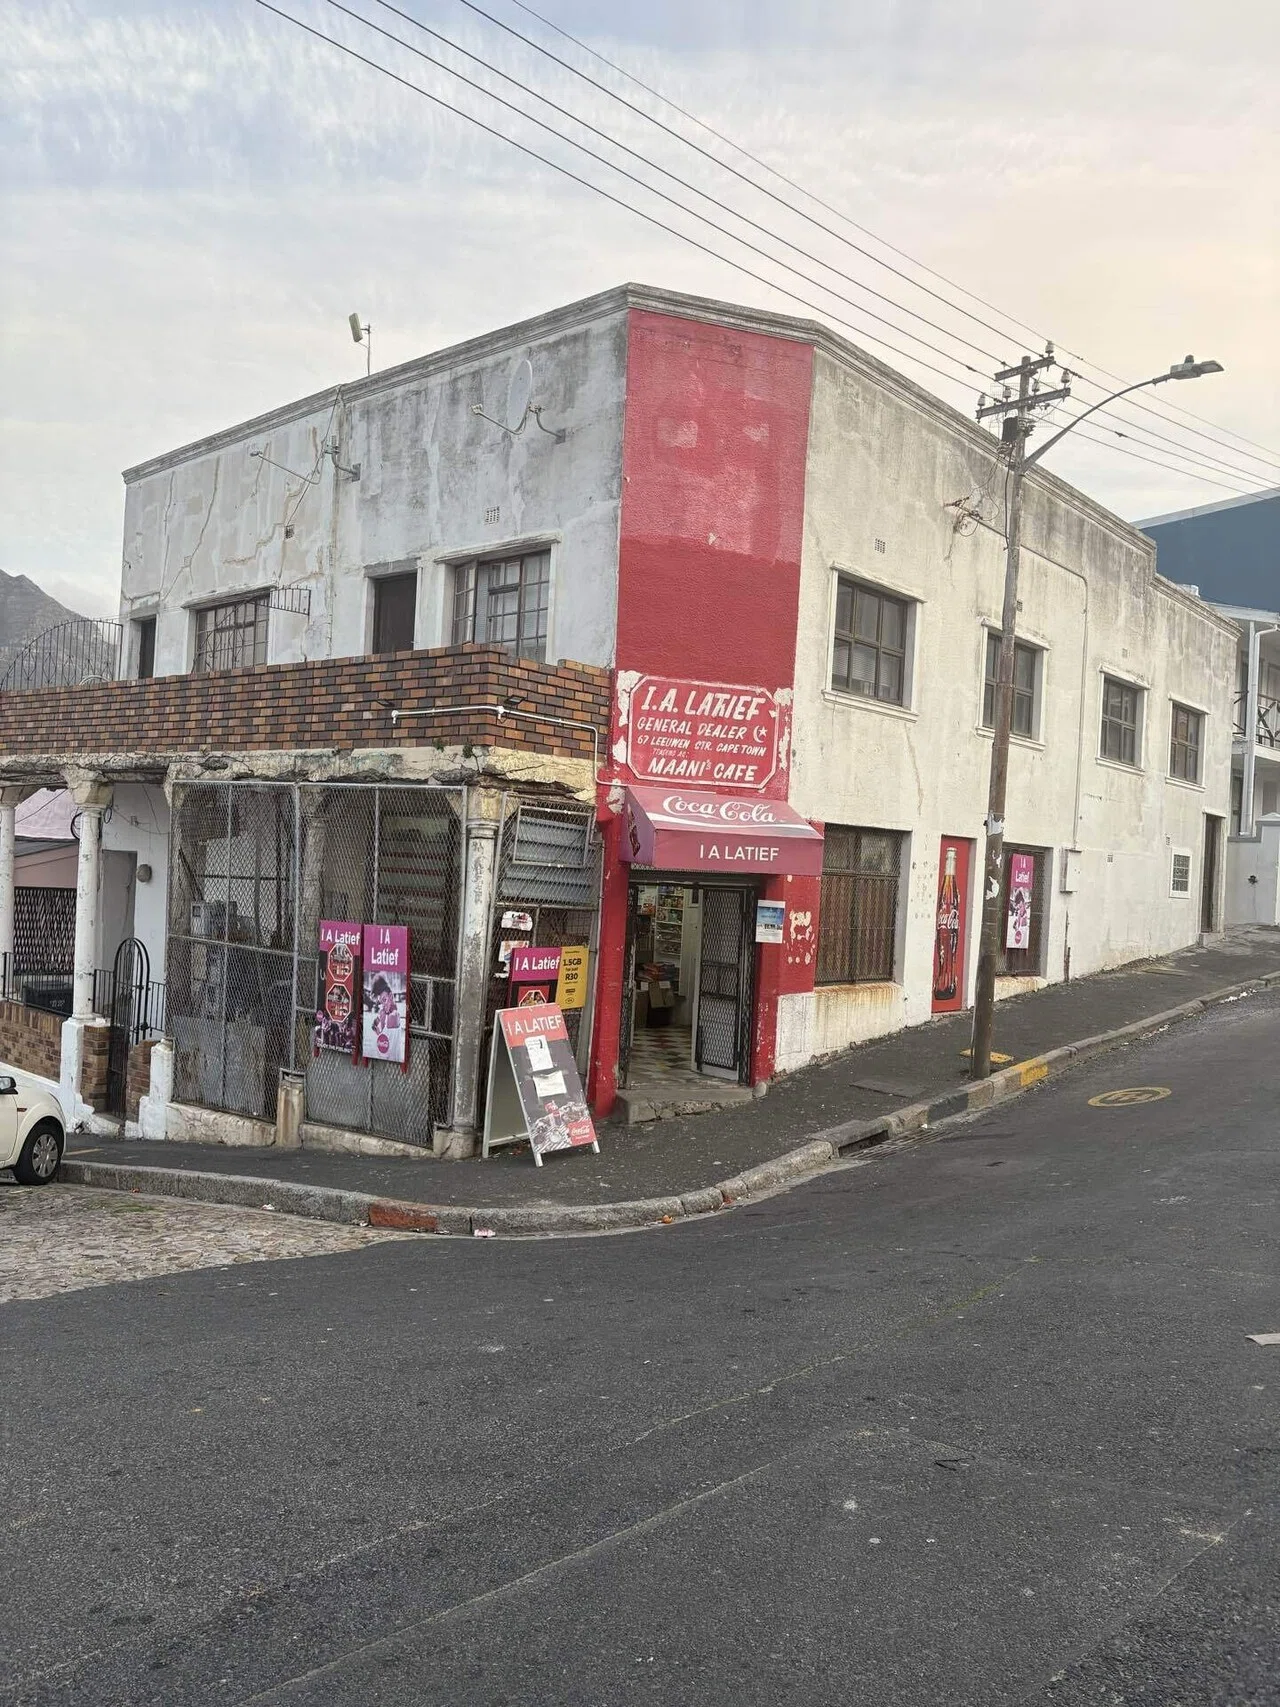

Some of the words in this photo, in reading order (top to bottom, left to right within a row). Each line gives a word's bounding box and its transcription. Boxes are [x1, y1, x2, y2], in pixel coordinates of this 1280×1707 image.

[641, 686, 679, 713] I.A.
[684, 690, 766, 721] LATIEF
[637, 716, 692, 735] GENERAL
[697, 723, 748, 740] DEALER
[637, 735, 649, 745] 67
[650, 736, 690, 749] LEEUWEN
[716, 742, 740, 753] CAPE
[741, 744, 767, 757] TOWN
[713, 763, 758, 781] CAFE
[662, 795, 777, 823] Coca-Cola
[700, 844, 704, 859] I
[708, 844, 720, 859] A
[724, 845, 780, 862] LATIEF
[321, 929, 325, 941] I
[326, 929, 333, 942] A
[334, 929, 361, 946] Latief
[380, 928, 383, 944] I
[384, 928, 391, 944] A
[371, 947, 399, 966] Latief
[515, 957, 519, 971] I
[521, 957, 529, 971] A
[532, 956, 560, 970] Latief
[565, 972, 579, 981] R30
[508, 1021, 513, 1036] I
[515, 1021, 523, 1035] A
[524, 1014, 562, 1034] LATIEF
